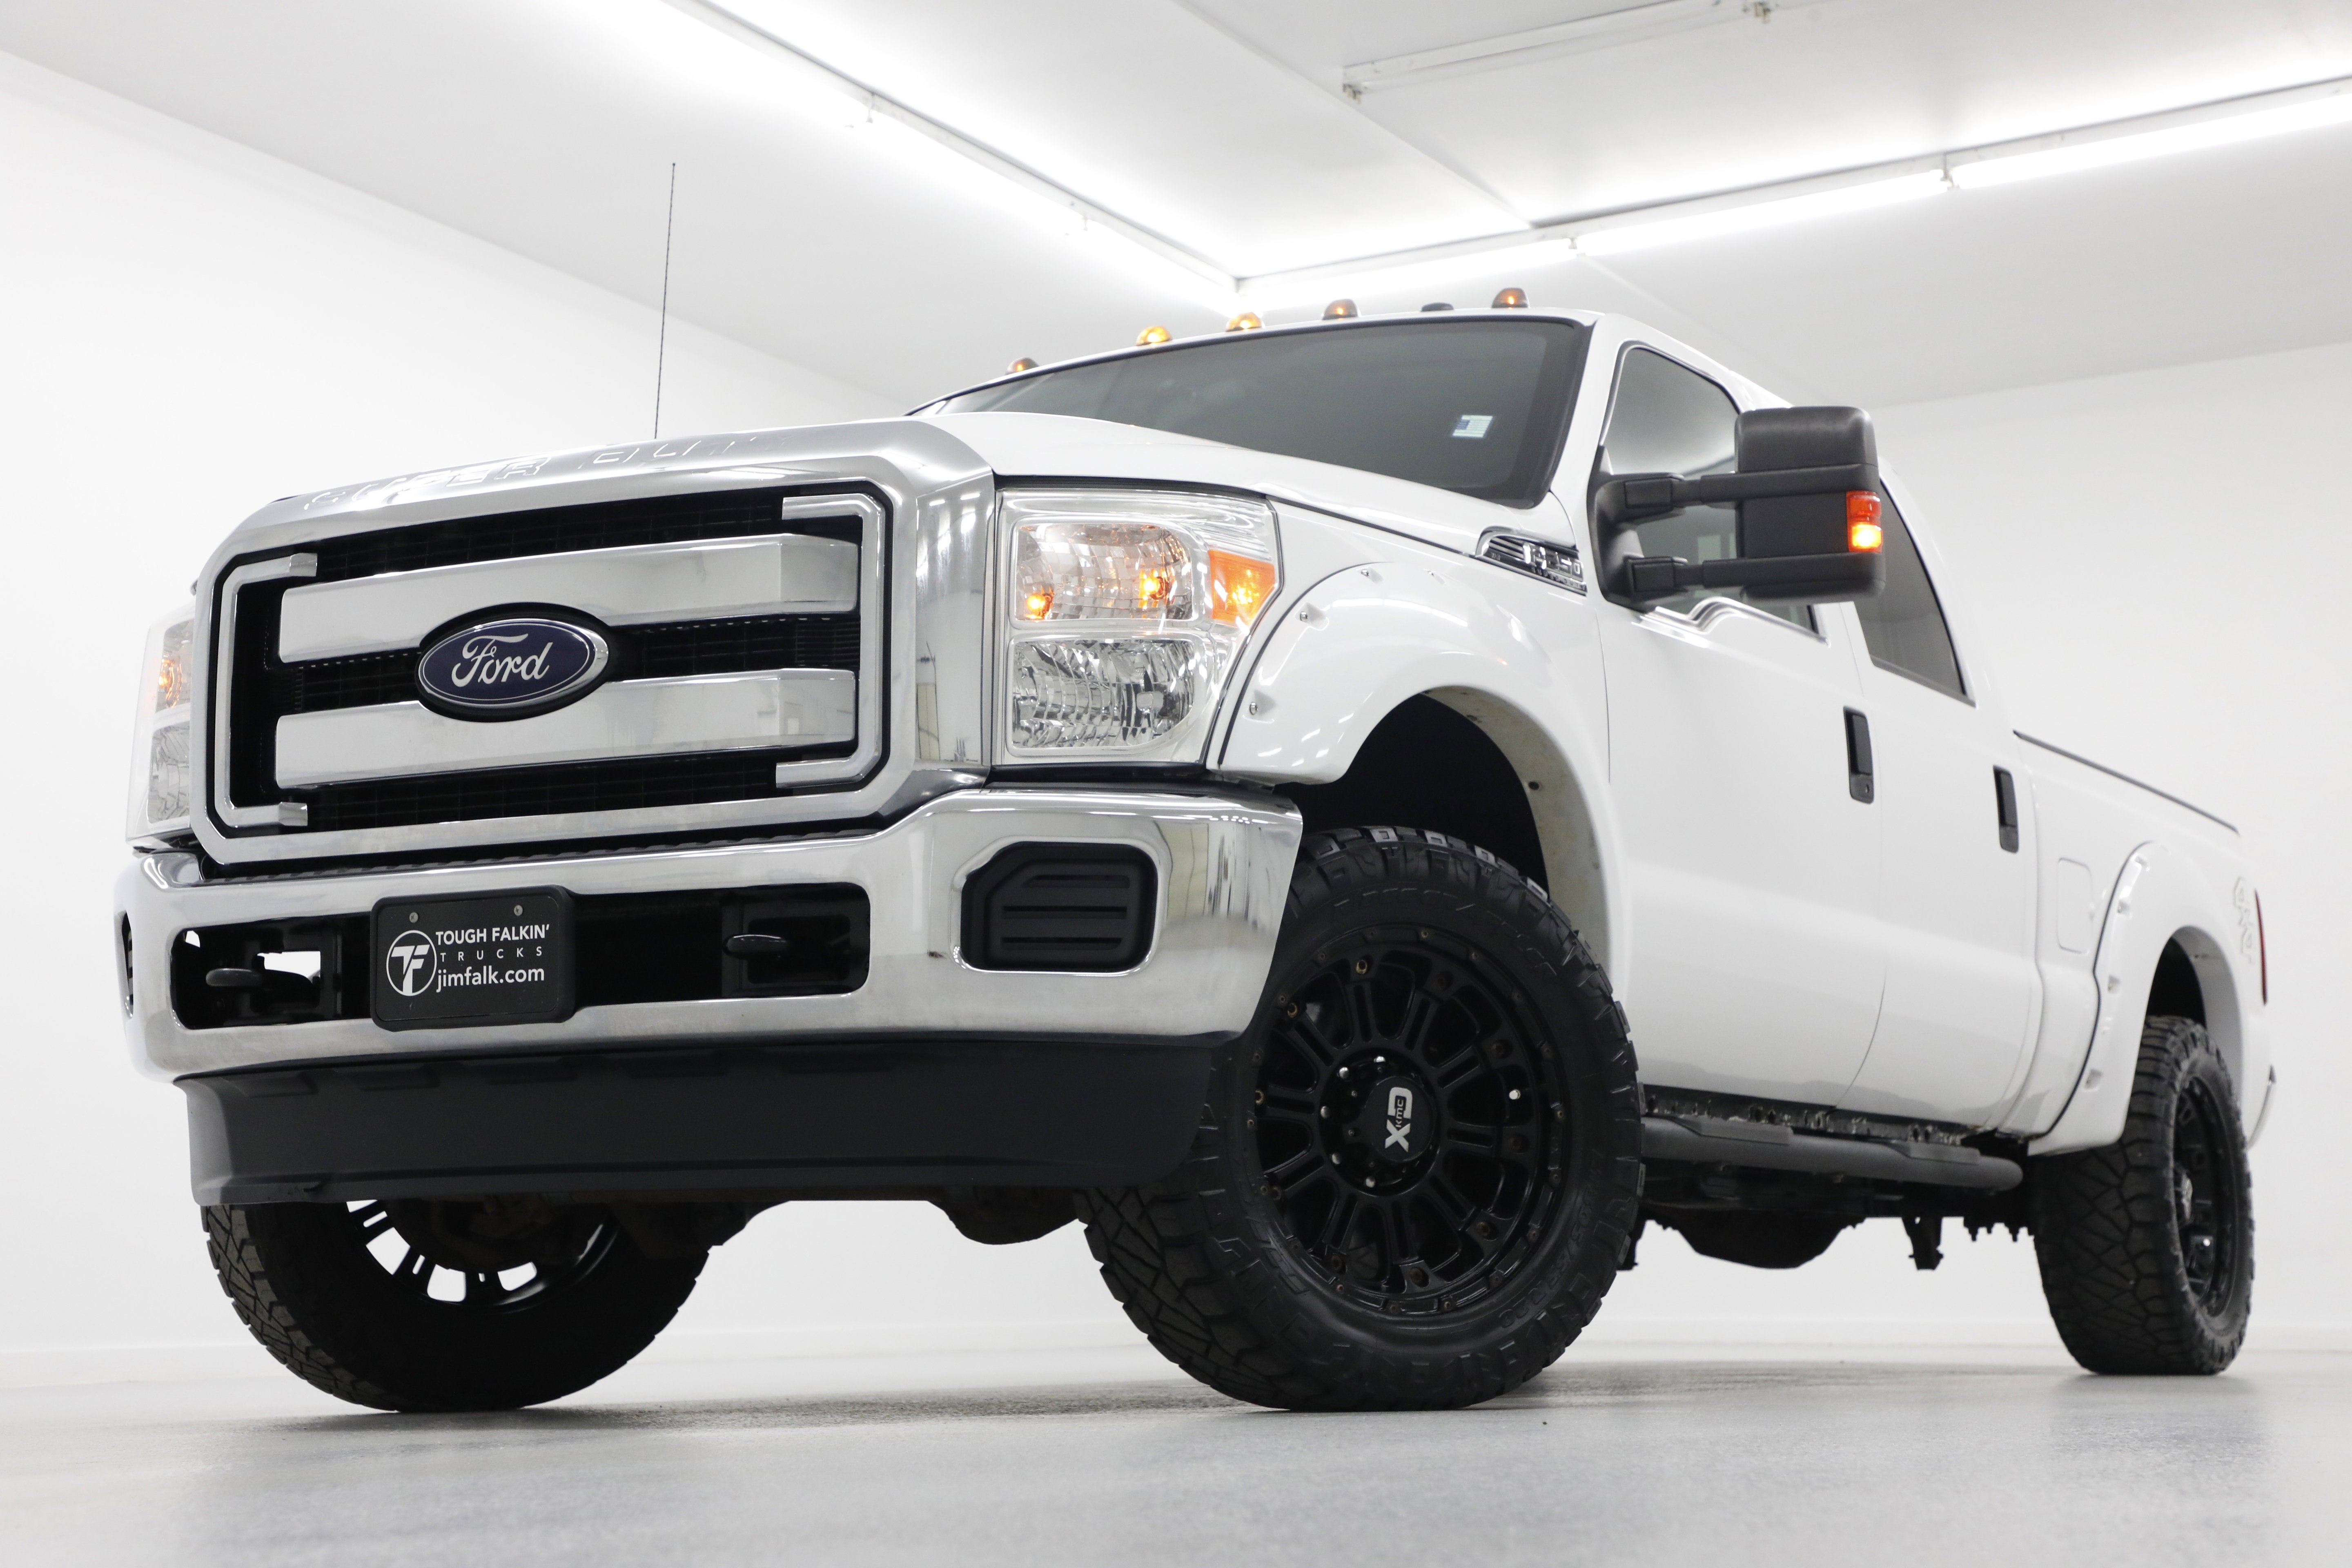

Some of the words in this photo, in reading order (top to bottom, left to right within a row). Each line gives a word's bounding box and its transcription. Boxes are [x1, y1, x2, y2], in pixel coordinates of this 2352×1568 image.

[452, 633, 553, 687] Ford
[436, 929, 487, 945] TOUGH
[492, 924, 550, 942] FALKIN'
[440, 947, 542, 962] TRUCKS
[437, 966, 545, 993] jimfalk.com
